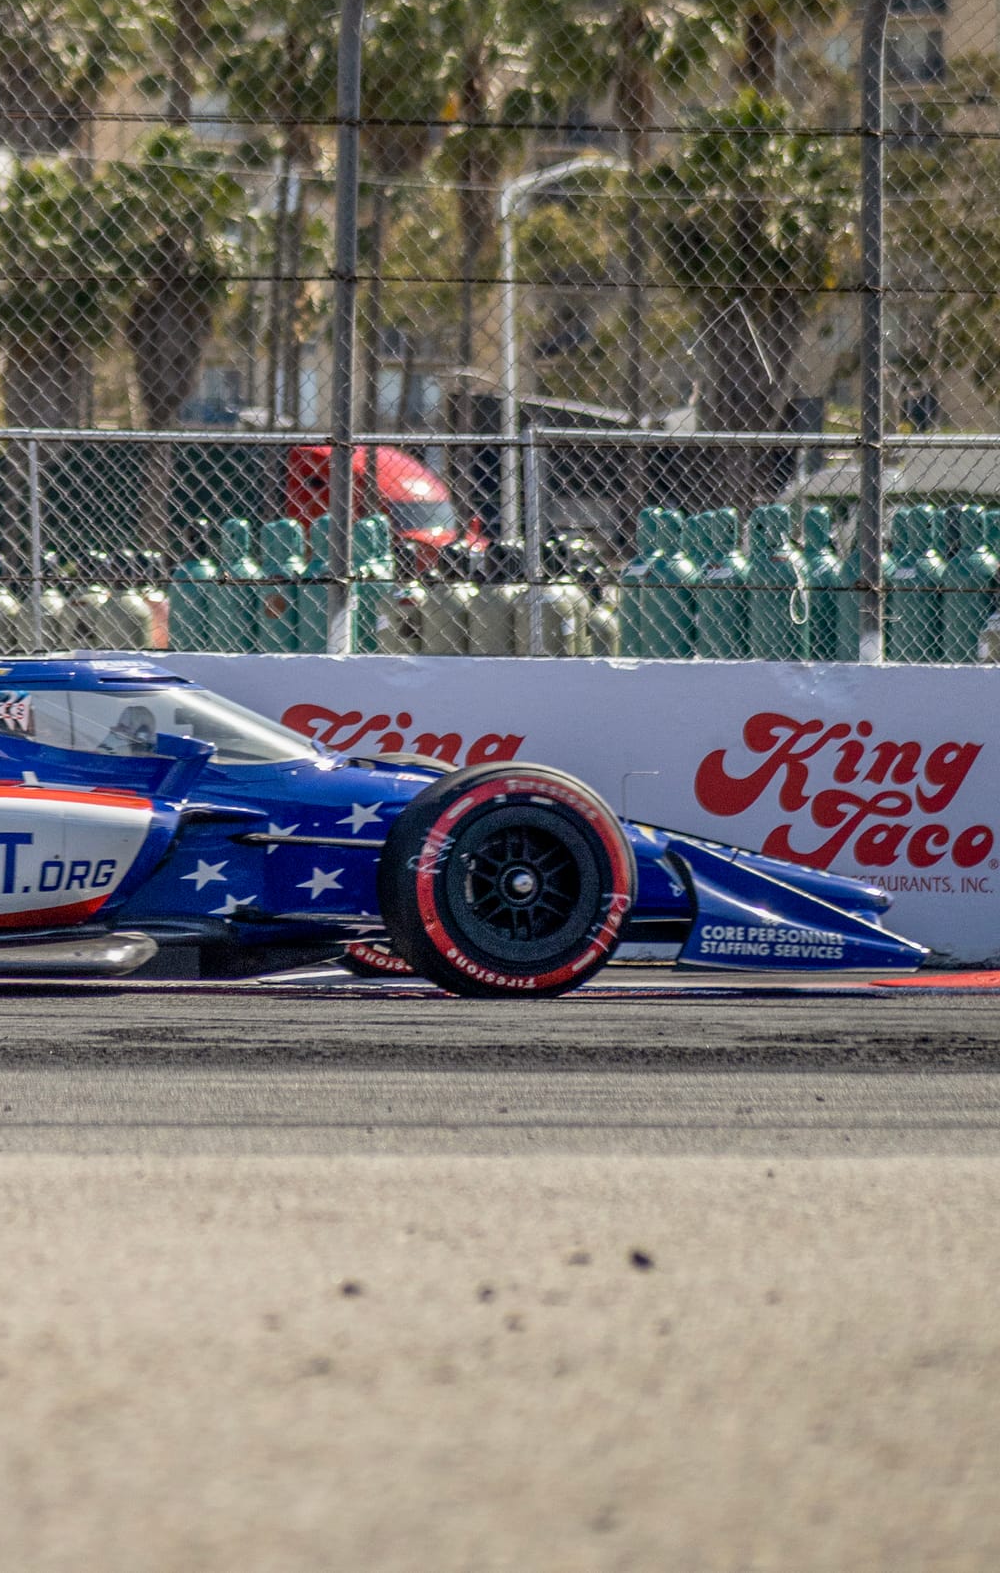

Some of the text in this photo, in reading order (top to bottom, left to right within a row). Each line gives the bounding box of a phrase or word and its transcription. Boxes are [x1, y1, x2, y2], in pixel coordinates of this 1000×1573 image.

[694, 712, 984, 817] King
[761, 789, 994, 870] Taco
[961, 877, 993, 893] INC.
[700, 941, 844, 960] STAFFING SERVICES
[701, 925, 847, 946] CORE PERSONNEL
[446, 947, 536, 990] Firestone
